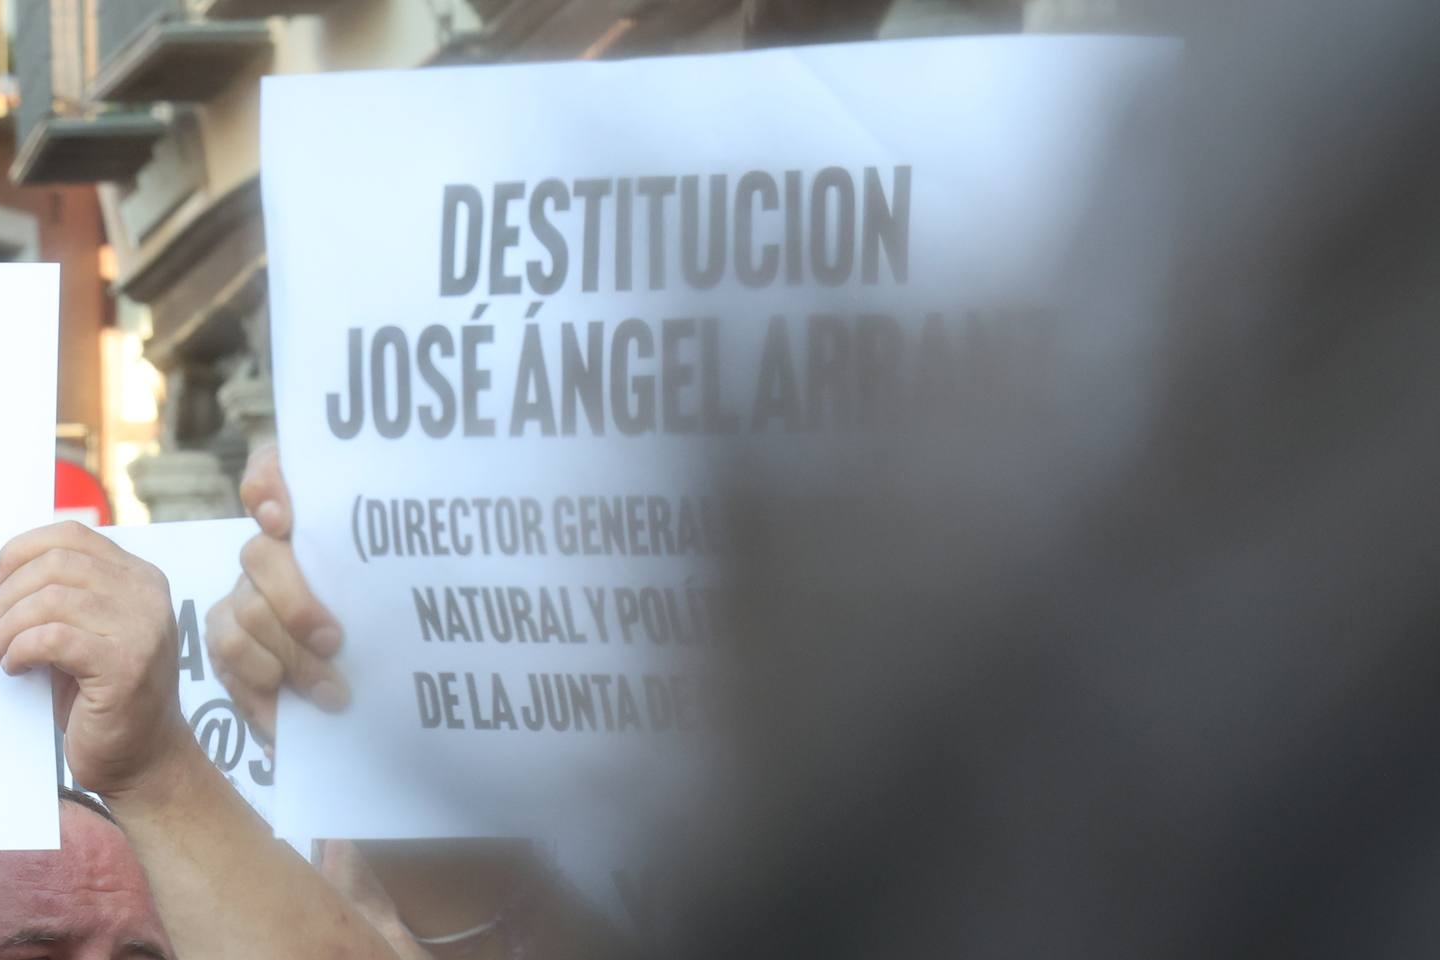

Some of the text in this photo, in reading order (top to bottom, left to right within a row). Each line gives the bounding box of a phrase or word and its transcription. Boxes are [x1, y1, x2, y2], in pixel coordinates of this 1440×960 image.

[438, 165, 912, 298] DESTITUCION
[325, 303, 497, 441] JOSÉ
[508, 300, 742, 438] ÁNGEL
[350, 494, 716, 562] (DIRECTOR GENERA
[411, 585, 588, 644] NATURAL
[583, 585, 610, 644] Y
[413, 671, 465, 730] DE
[464, 672, 519, 731] LA
[520, 673, 643, 732] JUNTA
